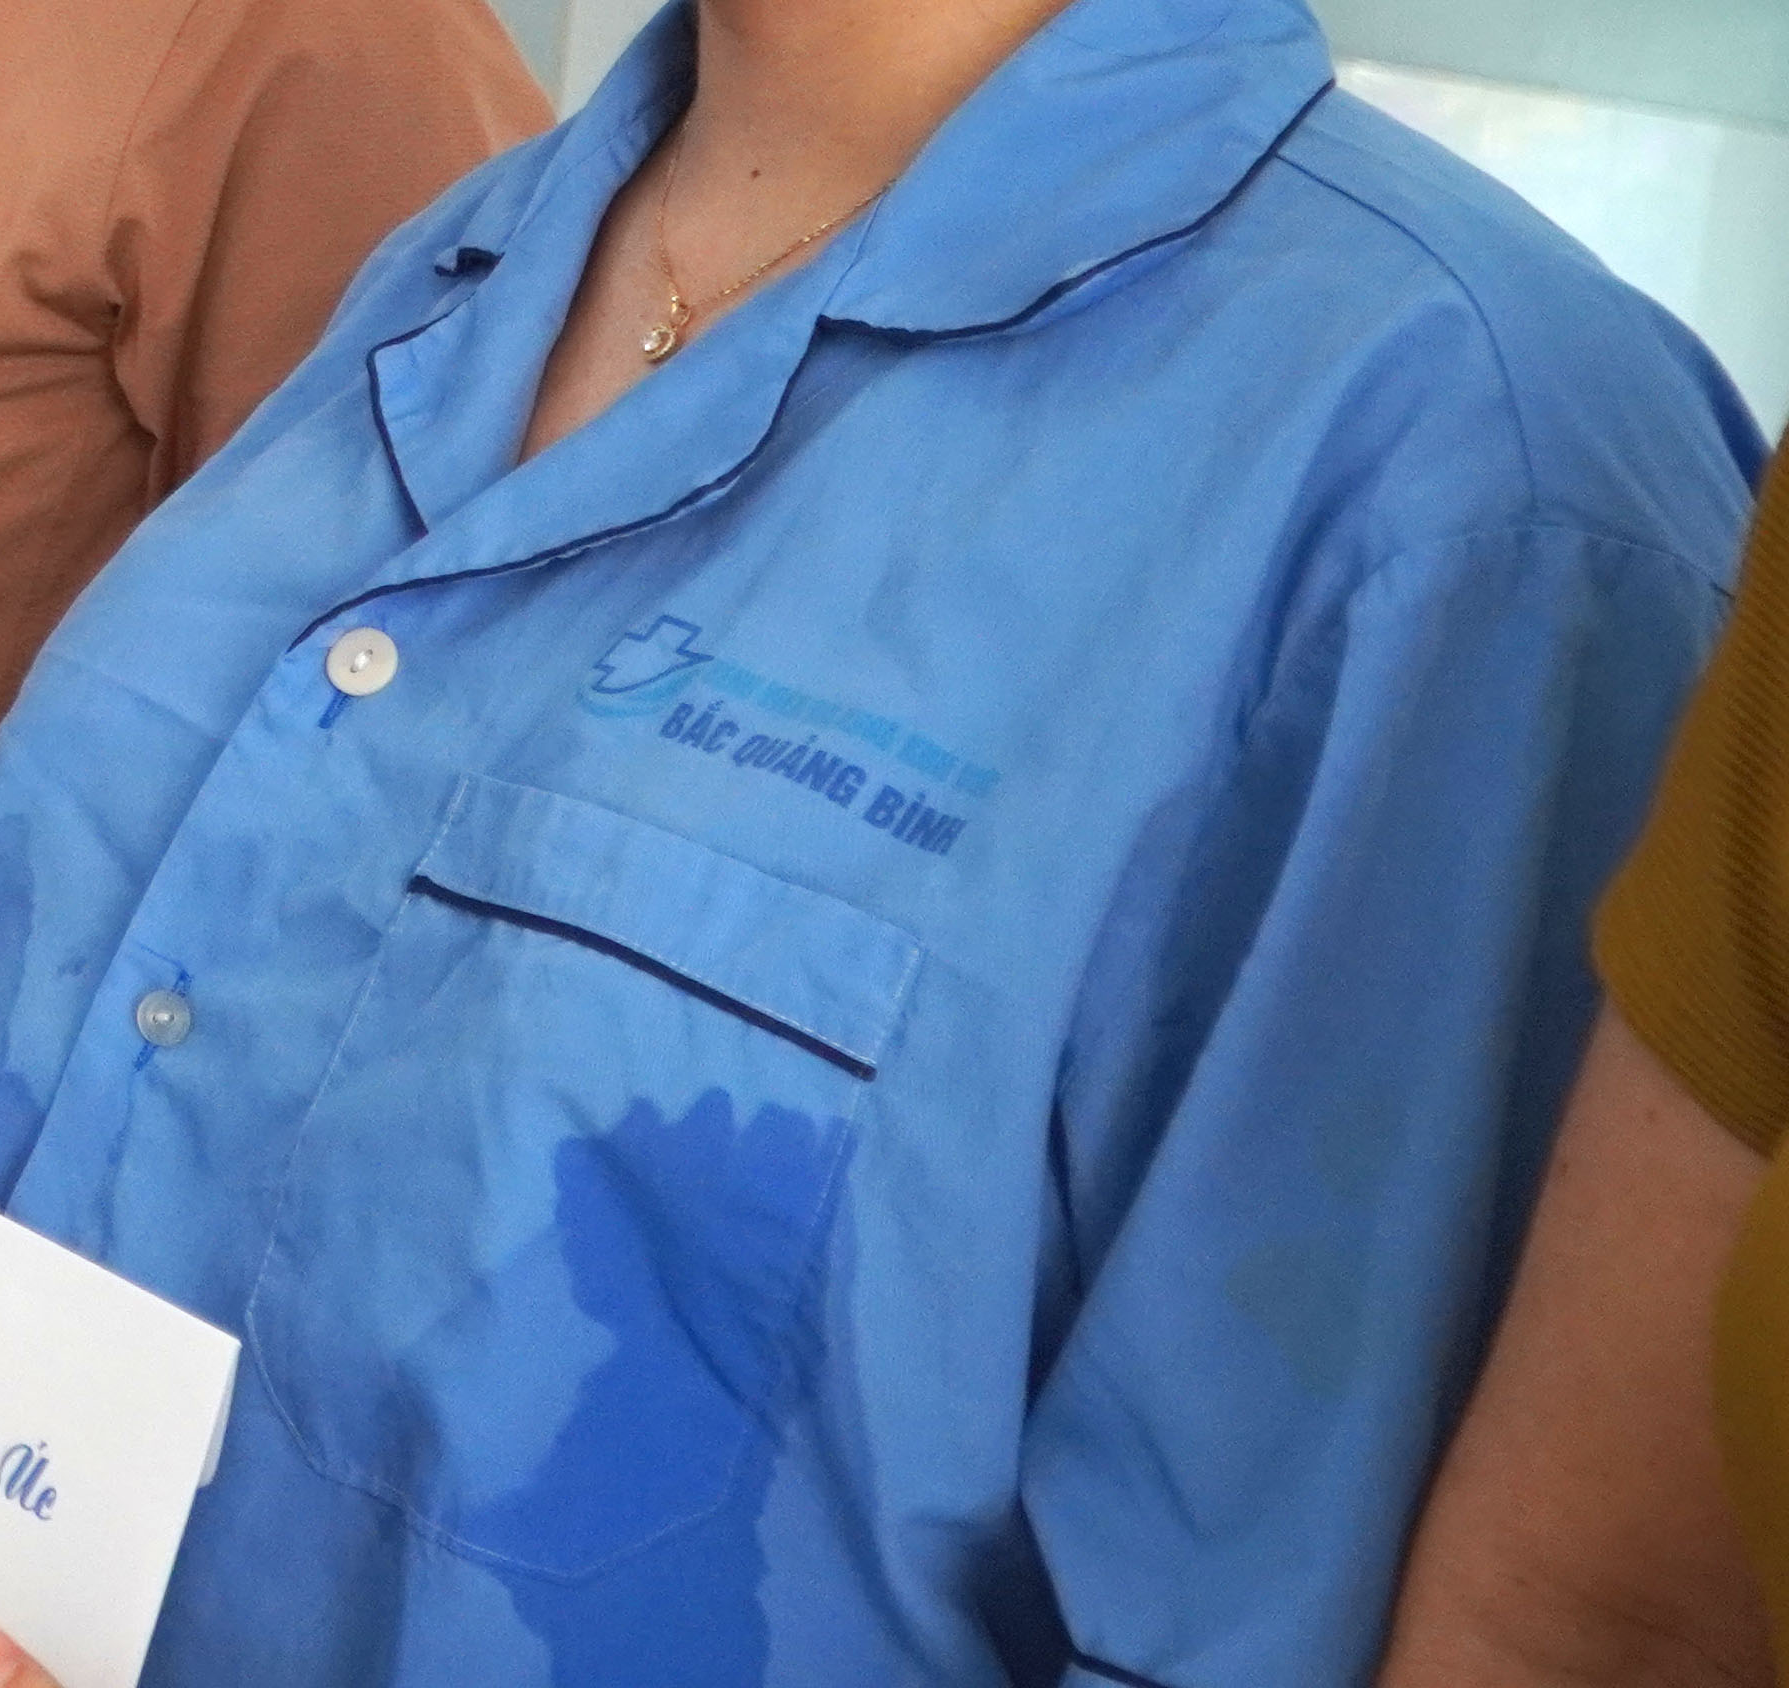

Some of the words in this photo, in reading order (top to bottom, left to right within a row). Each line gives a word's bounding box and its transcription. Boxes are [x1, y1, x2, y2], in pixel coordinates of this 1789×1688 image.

[659, 700, 740, 754] BẮC
[732, 734, 868, 809] QUẢNG
[863, 784, 969, 856] BÌNH
